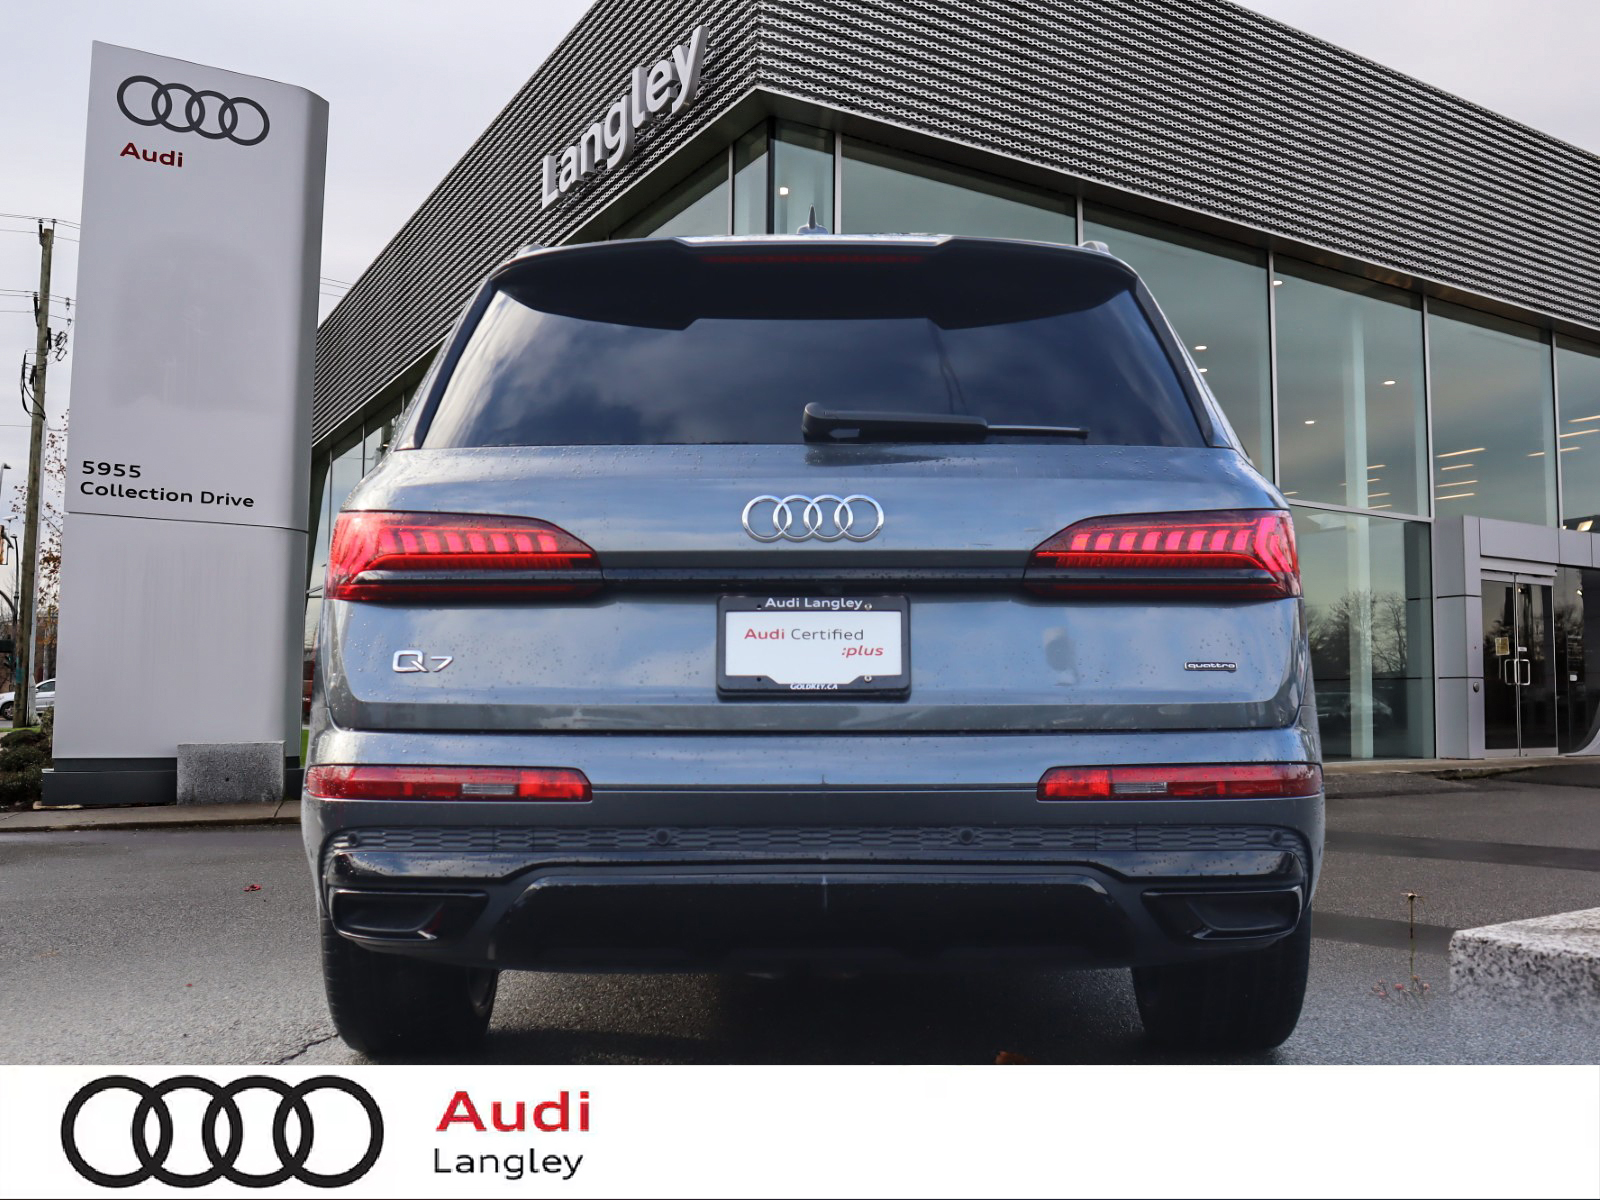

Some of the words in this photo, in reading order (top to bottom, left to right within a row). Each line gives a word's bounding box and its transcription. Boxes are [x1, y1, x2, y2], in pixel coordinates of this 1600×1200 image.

[541, 25, 709, 209] Langley
[120, 142, 183, 168] Audi
[82, 460, 141, 478] 5955
[80, 481, 193, 503] Collection
[200, 491, 255, 508] Drive
[764, 597, 800, 609] Audi
[804, 597, 864, 611] Langley
[744, 628, 785, 640] Audi
[790, 628, 865, 641] Certified
[392, 649, 454, 673] Q7
[1187, 662, 1236, 670] quattro
